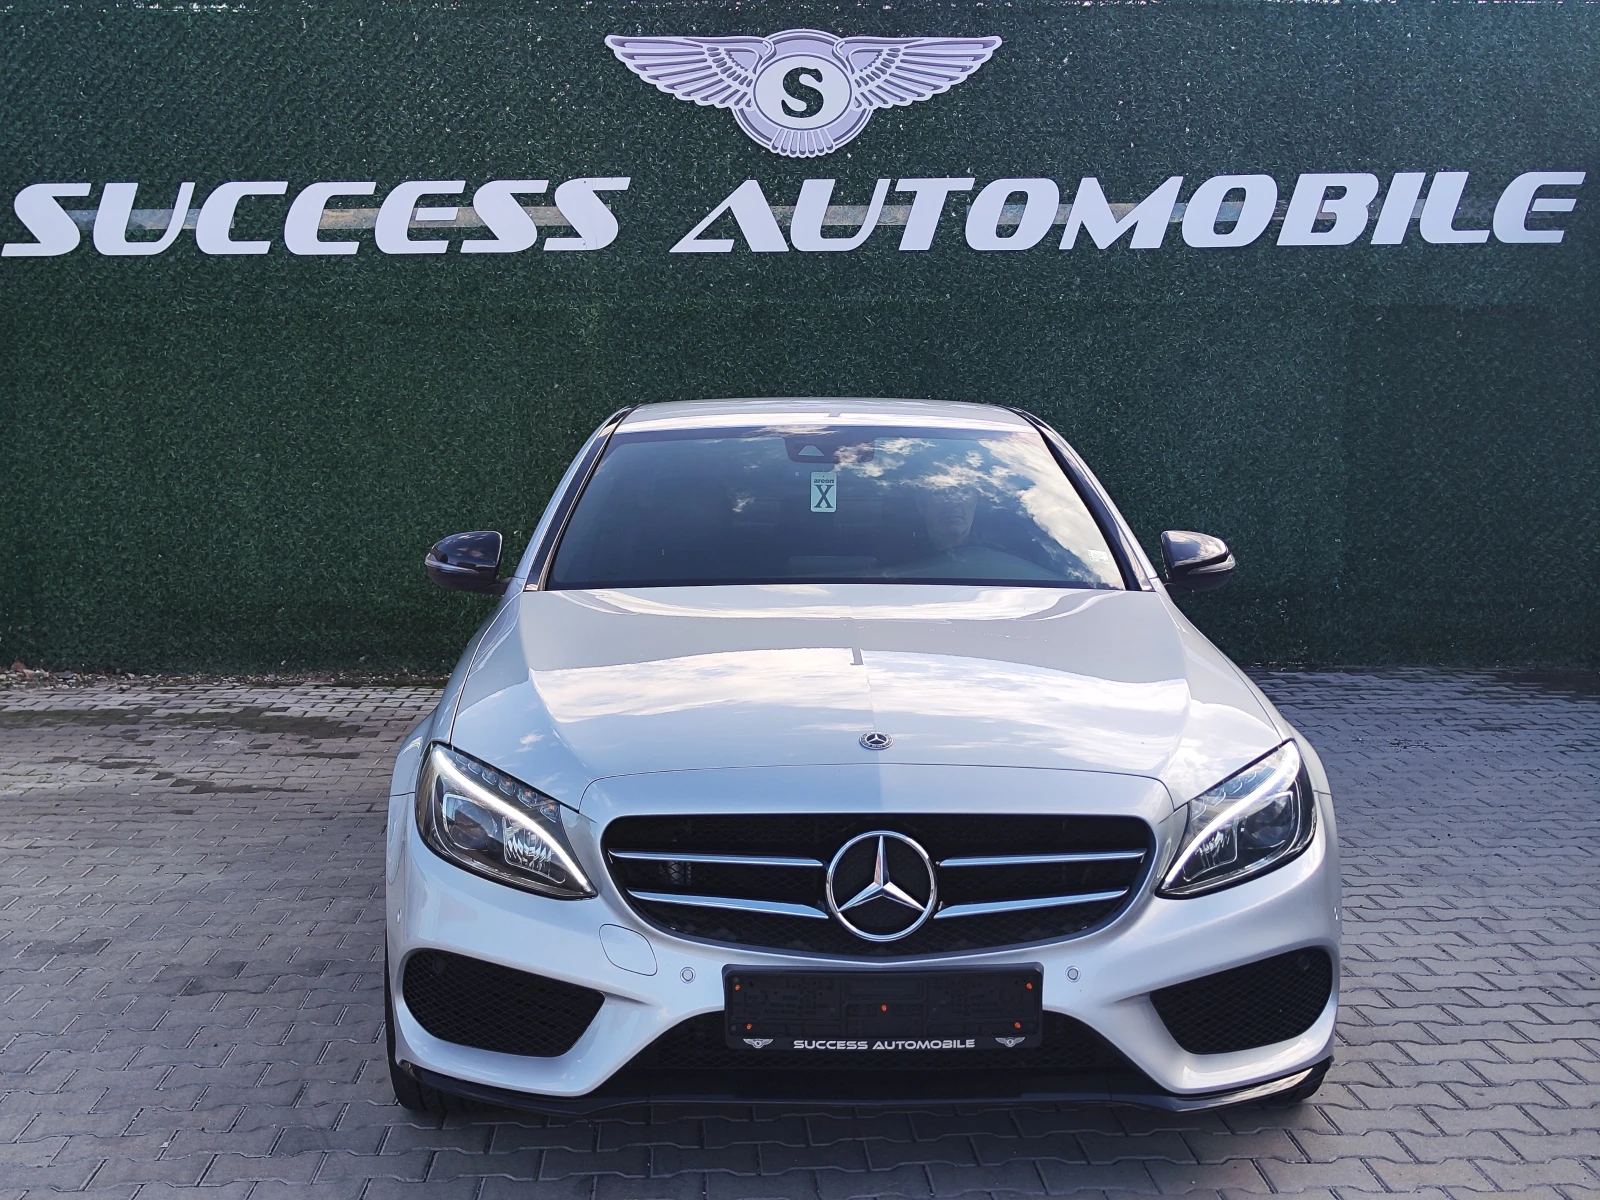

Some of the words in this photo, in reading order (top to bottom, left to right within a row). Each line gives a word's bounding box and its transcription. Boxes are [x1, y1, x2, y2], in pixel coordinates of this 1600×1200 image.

[781, 67, 824, 119] S
[2, 176, 631, 257] SUCCESS
[670, 171, 1586, 254] AUTOMOBILE
[814, 485, 834, 508] X
[793, 1040, 869, 1050] SUCCESS
[872, 1039, 976, 1050] AUTOMOBILE
